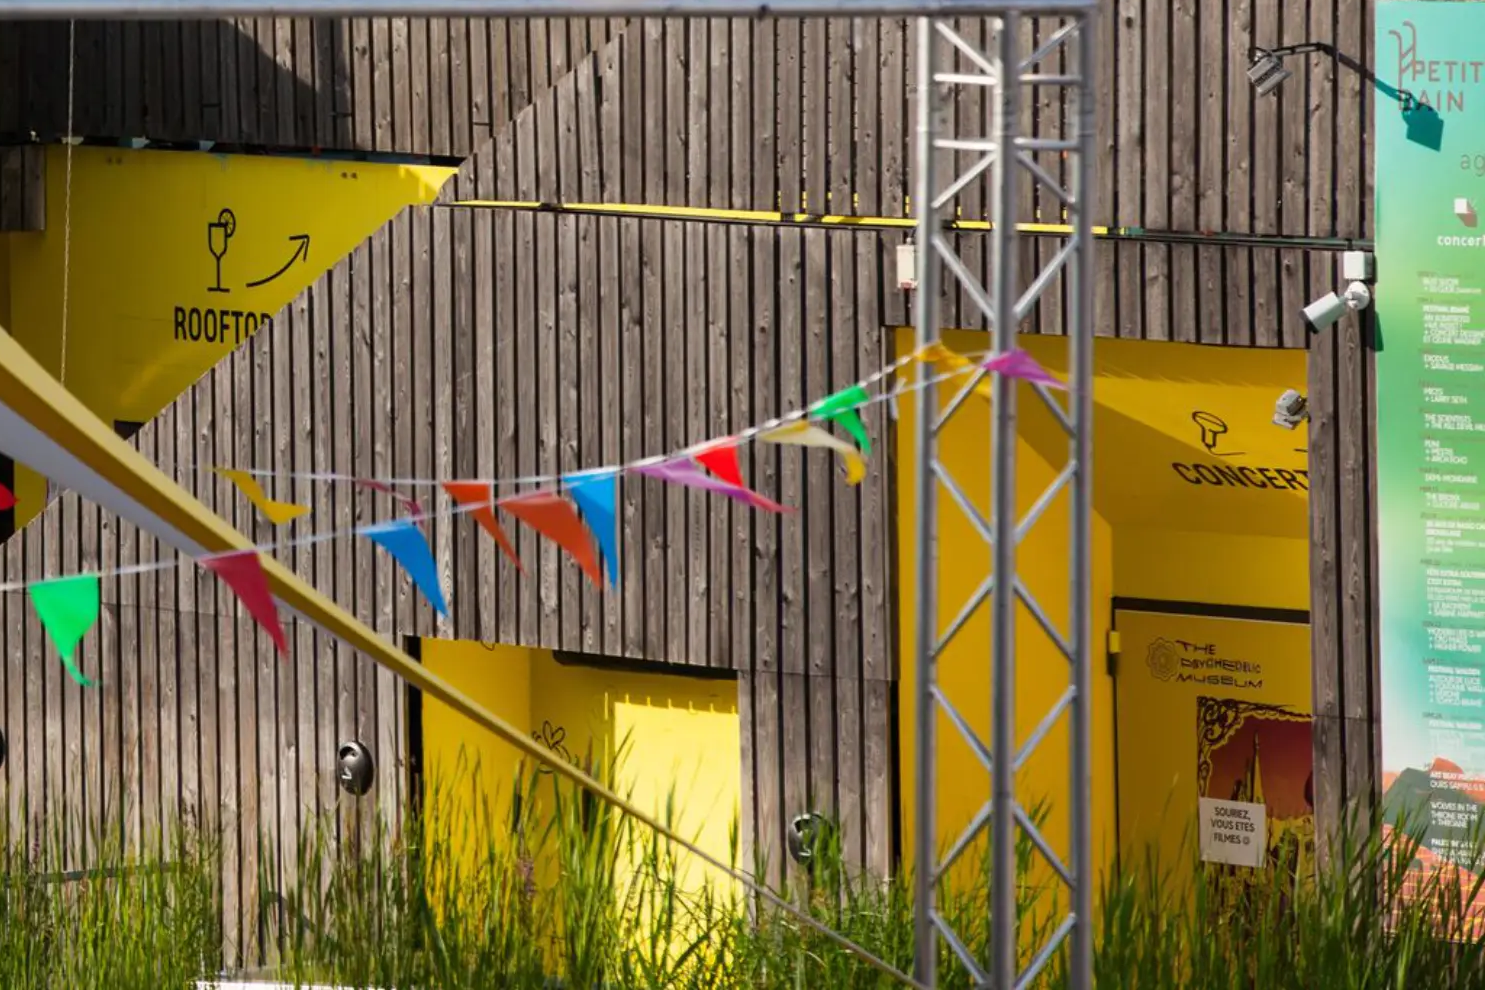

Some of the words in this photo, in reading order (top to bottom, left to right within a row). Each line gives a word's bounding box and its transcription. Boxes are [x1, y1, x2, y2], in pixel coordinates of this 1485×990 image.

[1412, 59, 1485, 84] PETIT
[1174, 638, 1217, 655] THE
[1180, 657, 1262, 674] PSYCHEDELIC
[1175, 673, 1263, 688] MUSEUM
[1210, 818, 1234, 830] VOUS
